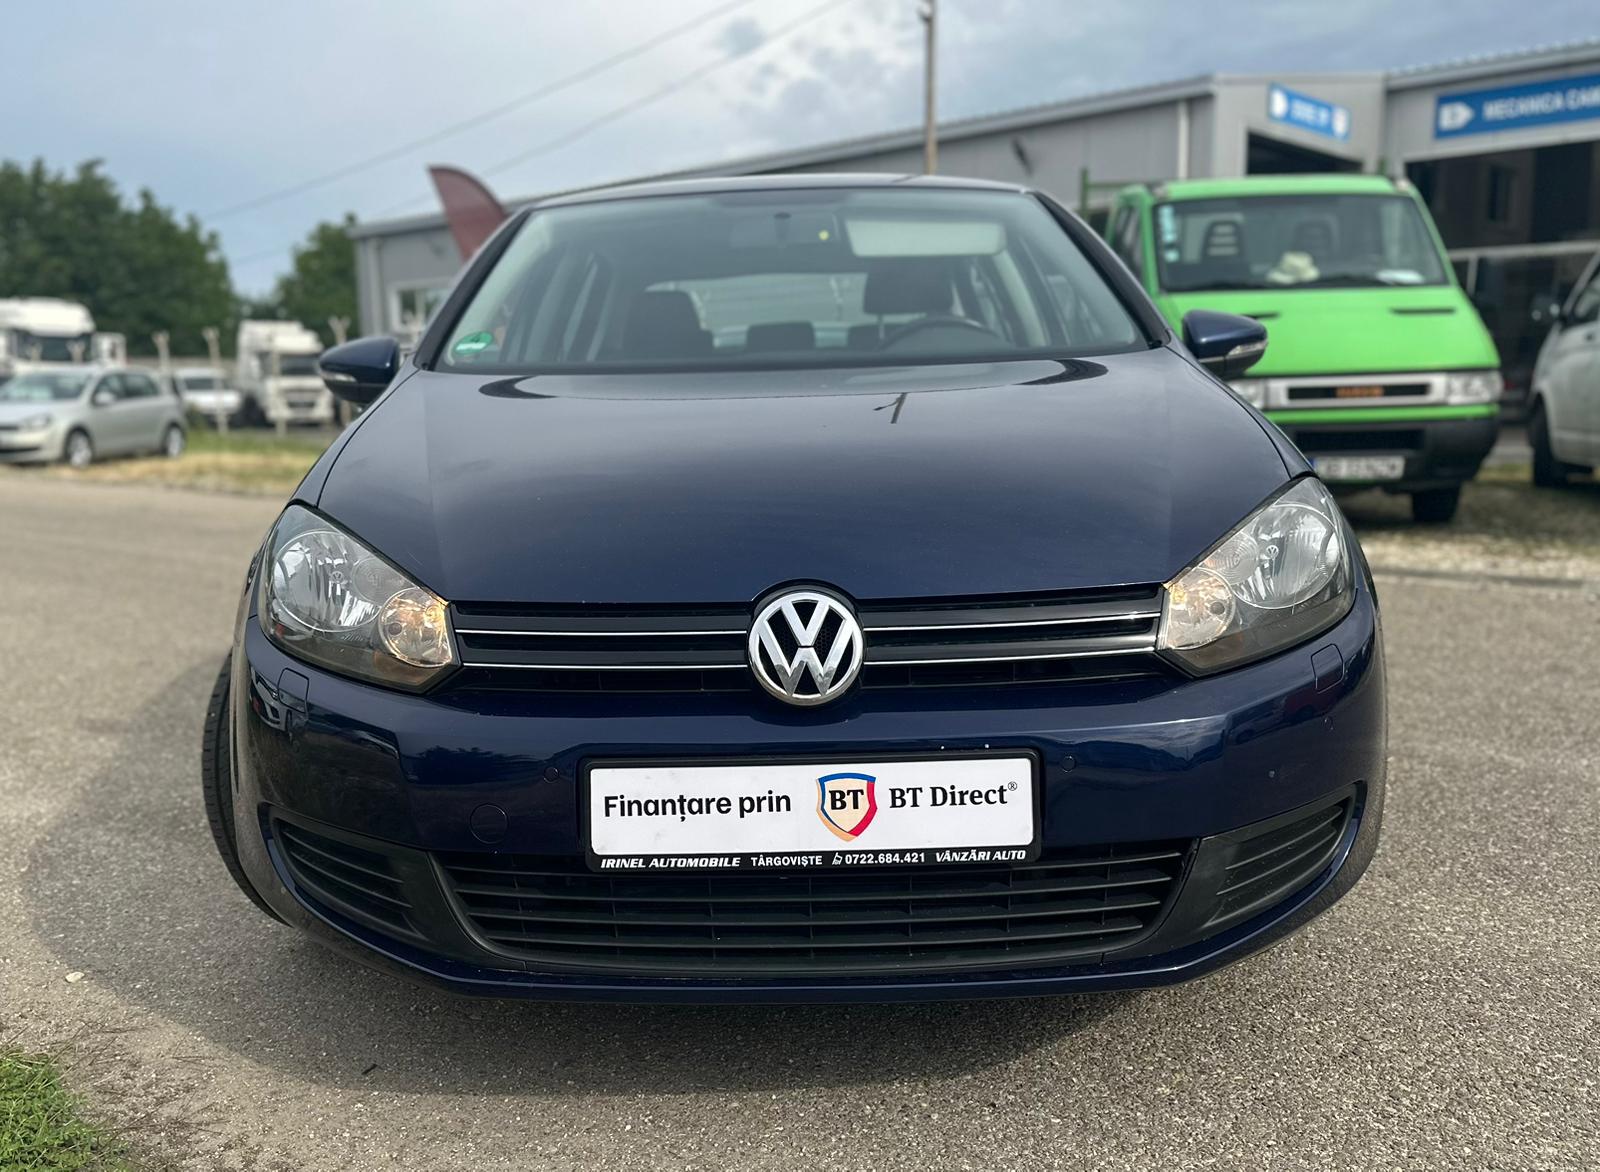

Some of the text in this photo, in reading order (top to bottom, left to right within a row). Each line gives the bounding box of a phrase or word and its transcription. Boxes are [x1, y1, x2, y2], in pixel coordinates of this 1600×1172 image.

[748, 592, 863, 706] VW
[604, 789, 791, 822] Finanțare prin
[828, 789, 864, 811] BT
[889, 787, 923, 809] BT
[600, 858, 646, 869] IRINEL
[648, 857, 741, 868] AUTOMOBILE
[845, 852, 925, 865] 0722.684.421
[992, 850, 1026, 860] AUTO
